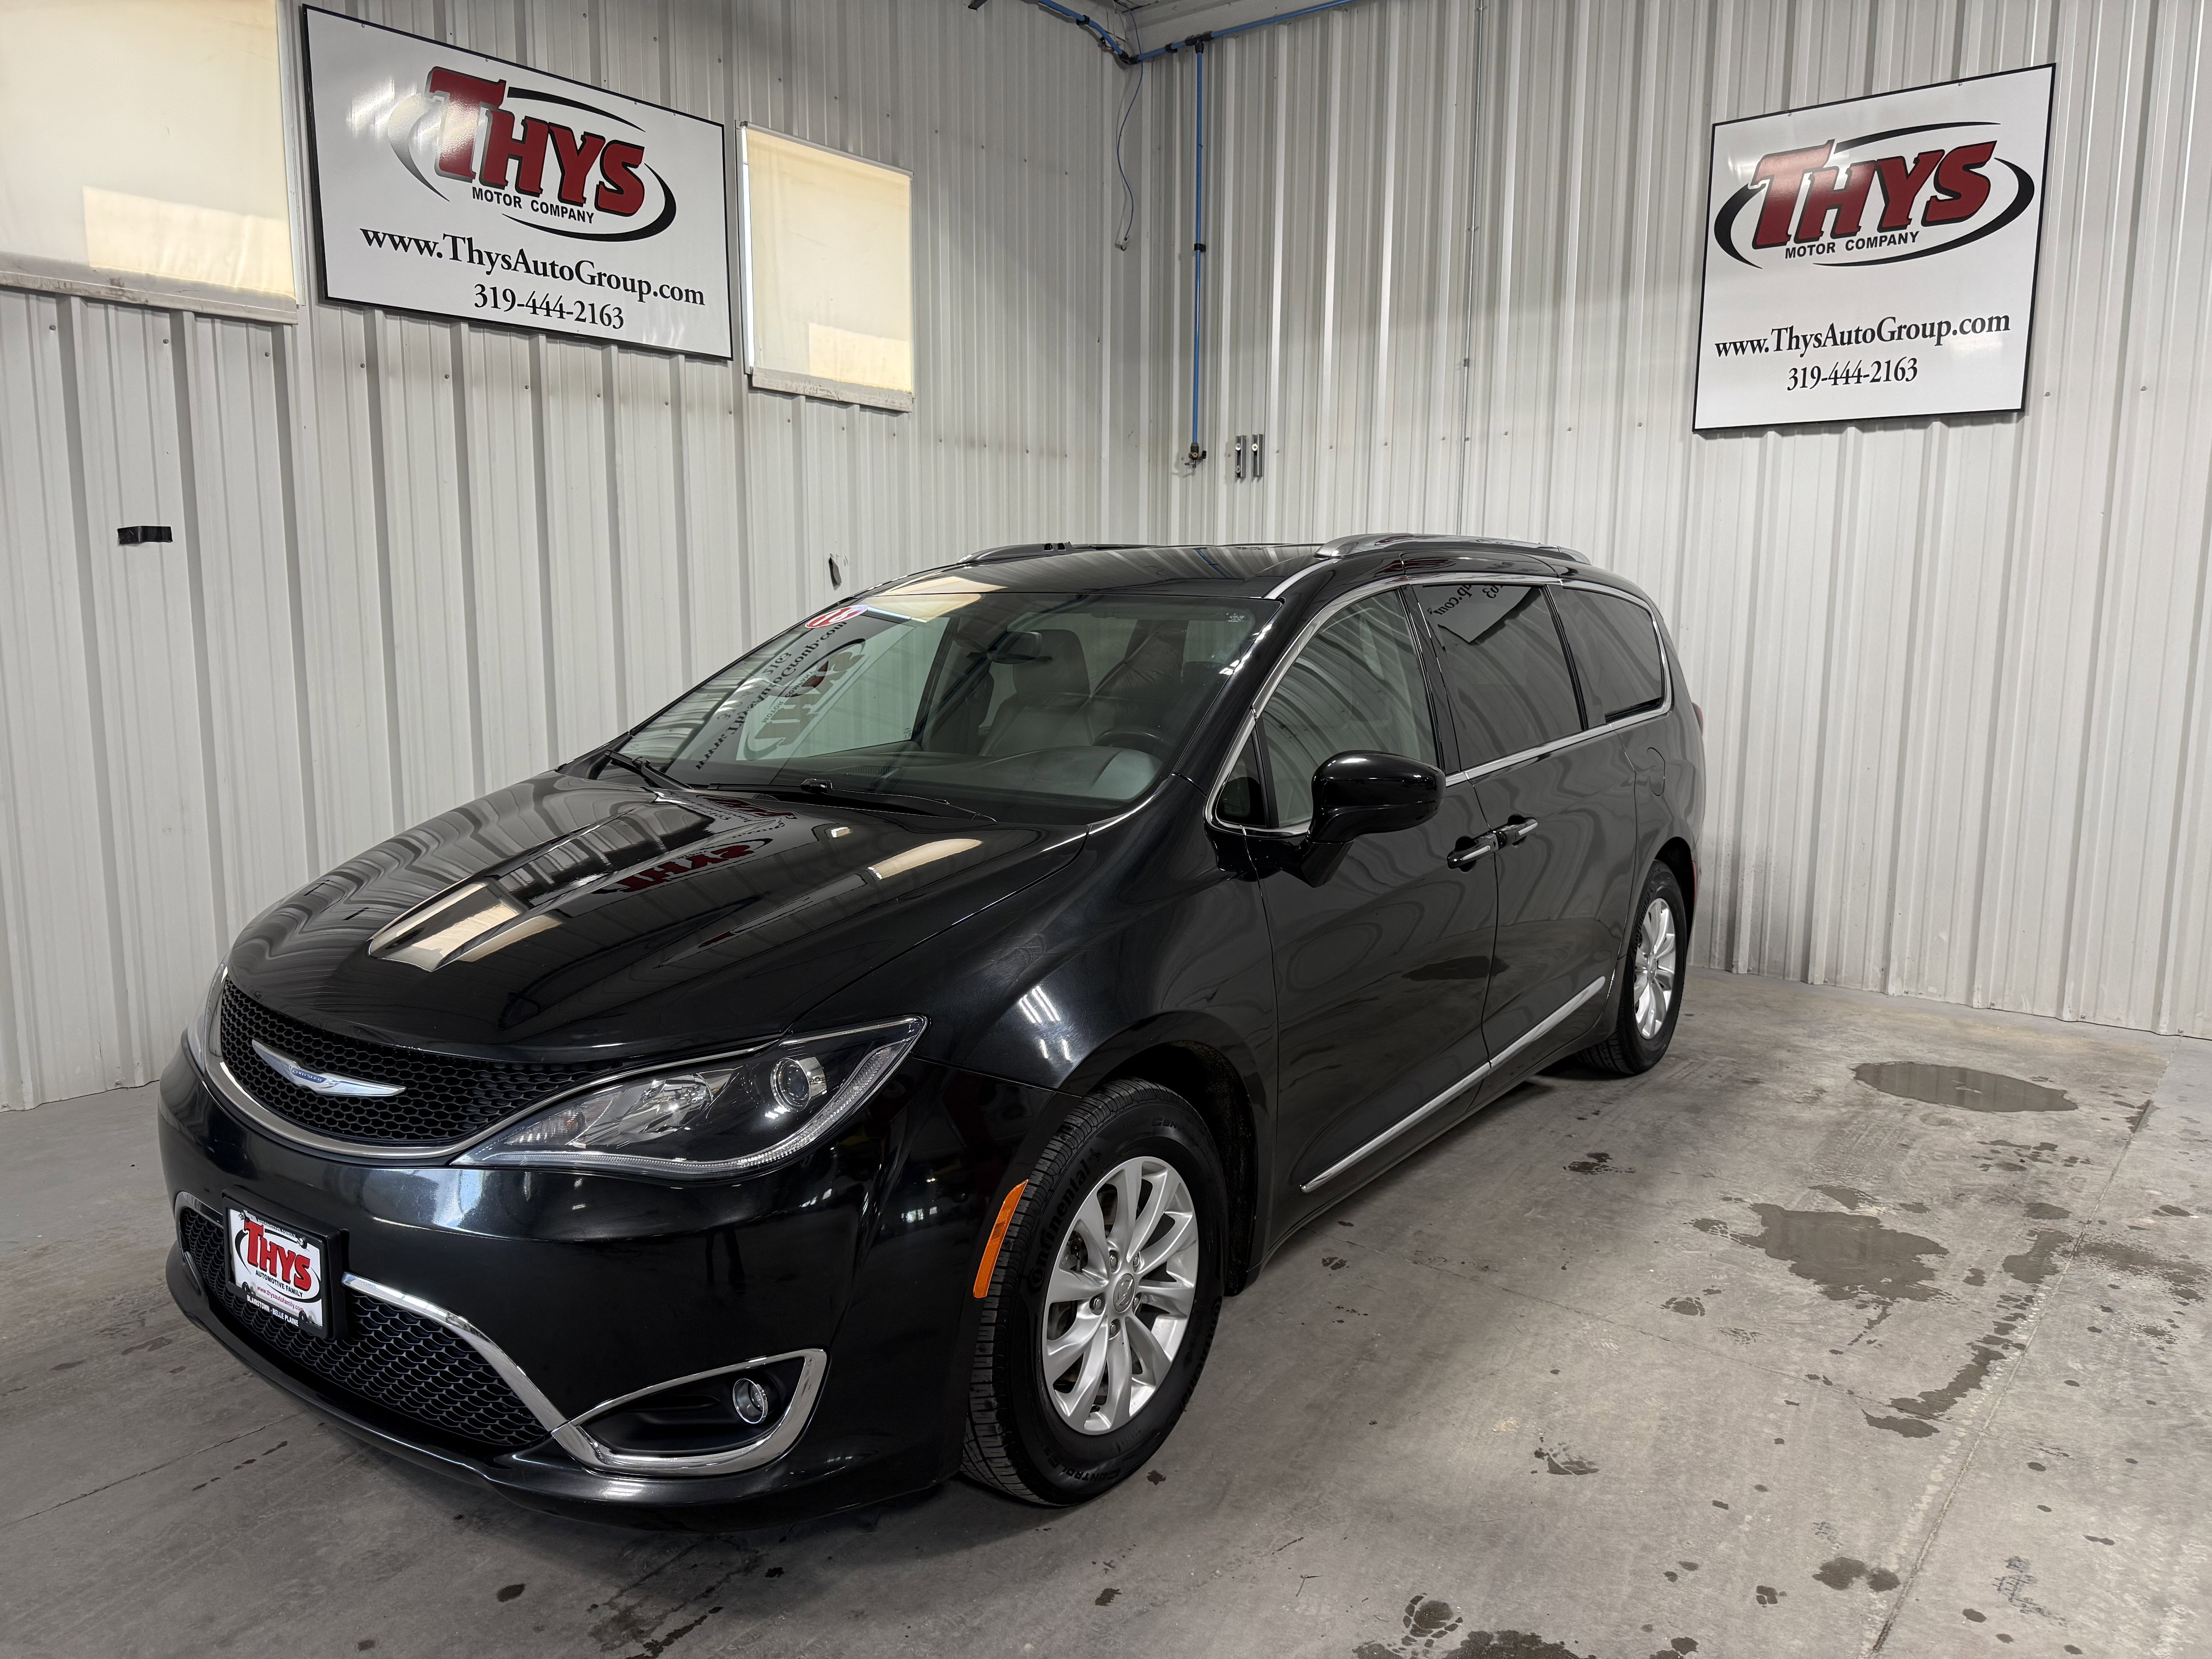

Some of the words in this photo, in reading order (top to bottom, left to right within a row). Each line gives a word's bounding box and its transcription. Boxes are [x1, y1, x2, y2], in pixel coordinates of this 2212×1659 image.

[425, 66, 646, 217] THYS
[472, 186, 523, 210] MOTOR
[530, 199, 595, 225] COMPANY
[1748, 139, 1998, 250] THYS
[1784, 242, 1836, 259] MOTOR
[1845, 230, 1920, 251] COMPANY
[359, 228, 706, 306] www.ThysAutoGroup.com
[474, 283, 625, 330] 319-444-2163
[1714, 314, 2010, 357] www.ThysAutoGroup.com
[1786, 357, 1918, 391] 319-444-2163
[293, 1069, 322, 1082] CHRYSLER
[244, 1219, 312, 1291] THYS
[255, 1270, 285, 1290] AUTOMOTIVE
[285, 1285, 303, 1298] FAMILY
[247, 1295, 270, 1312] BLAIRSTOWN
[272, 1308, 284, 1318] BELLE
[284, 1313, 299, 1327] PLAINE
